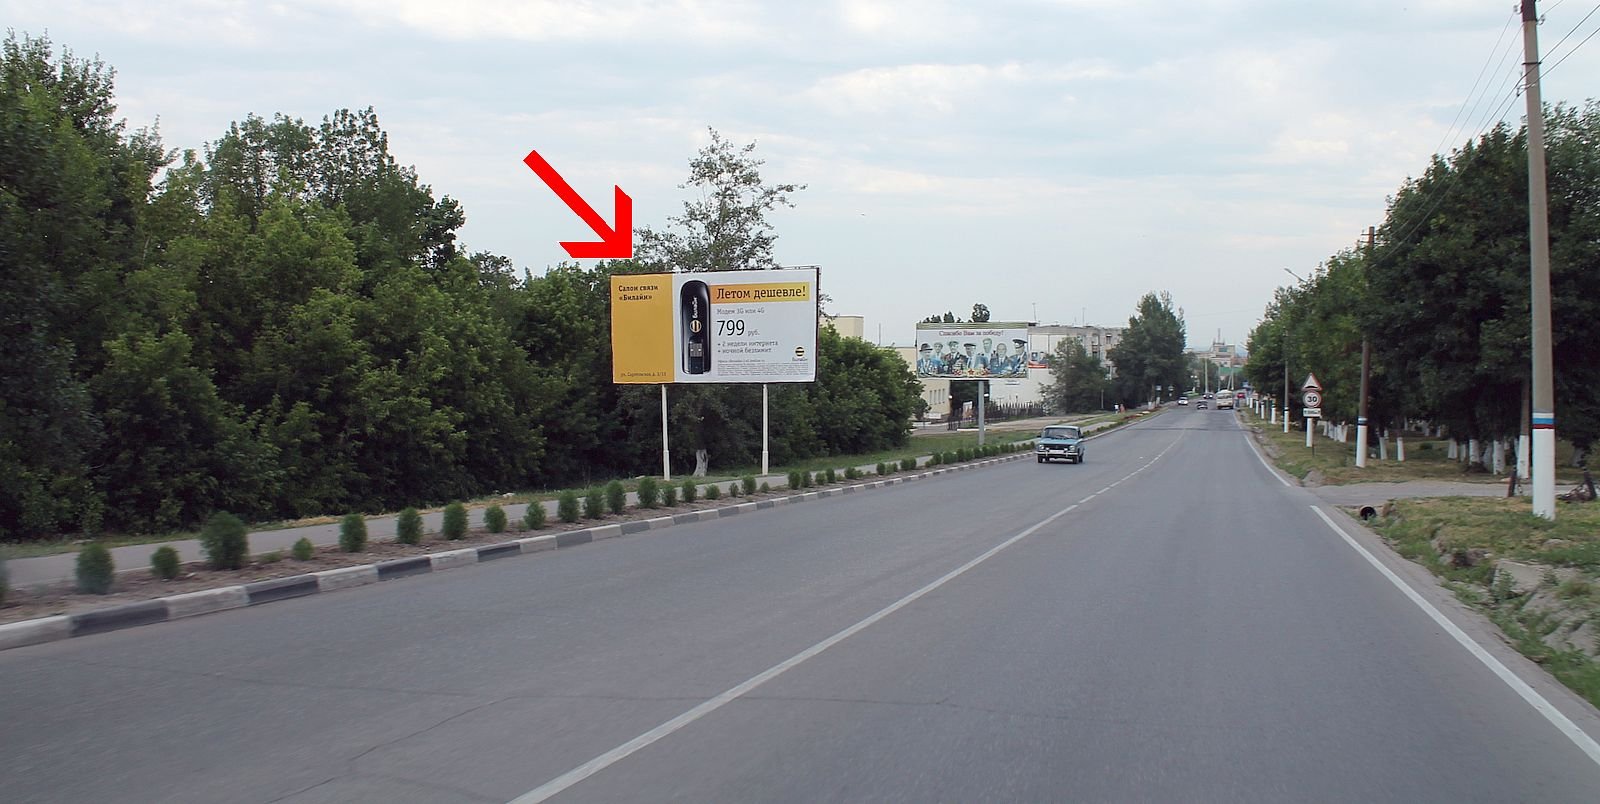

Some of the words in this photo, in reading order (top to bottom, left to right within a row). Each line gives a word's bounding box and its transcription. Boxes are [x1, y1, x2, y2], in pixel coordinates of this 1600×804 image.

[717, 288, 750, 299] Летом
[754, 286, 806, 300] дешевле!
[716, 320, 744, 336] 799
